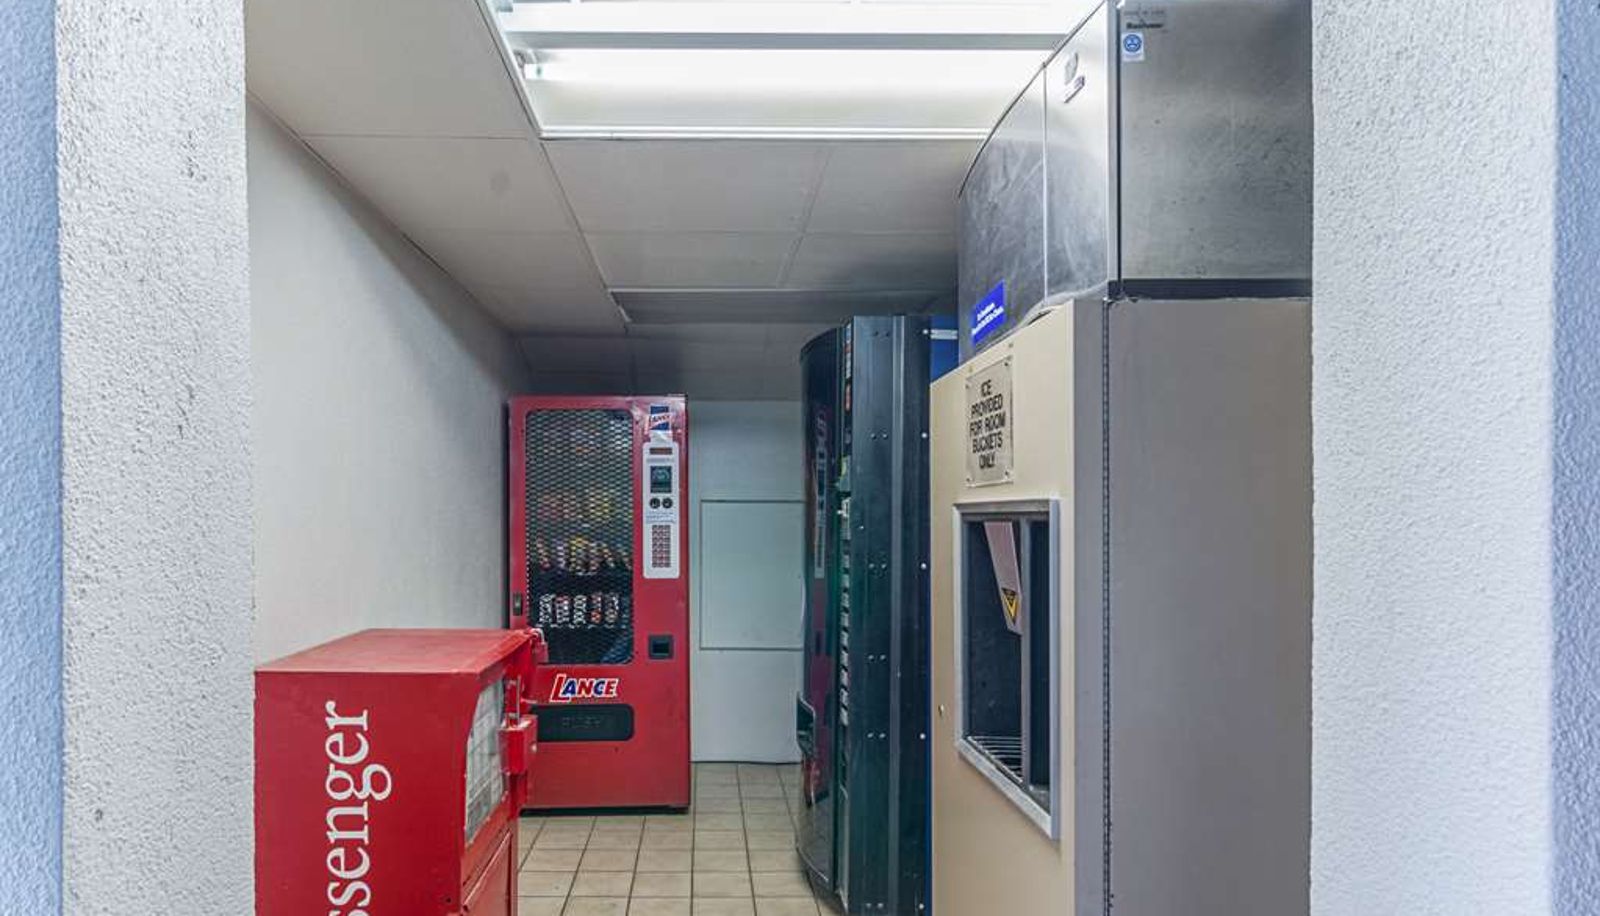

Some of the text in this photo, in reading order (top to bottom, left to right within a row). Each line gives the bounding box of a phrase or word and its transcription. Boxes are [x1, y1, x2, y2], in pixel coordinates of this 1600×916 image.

[980, 379, 992, 397] ICE
[971, 393, 1003, 418] PROVIDED
[969, 411, 1006, 438] FOR ROOM
[972, 430, 1003, 453] BUCKETS
[979, 453, 995, 469] ONLY
[550, 674, 619, 703] LANCE
[325, 700, 392, 916] senger
